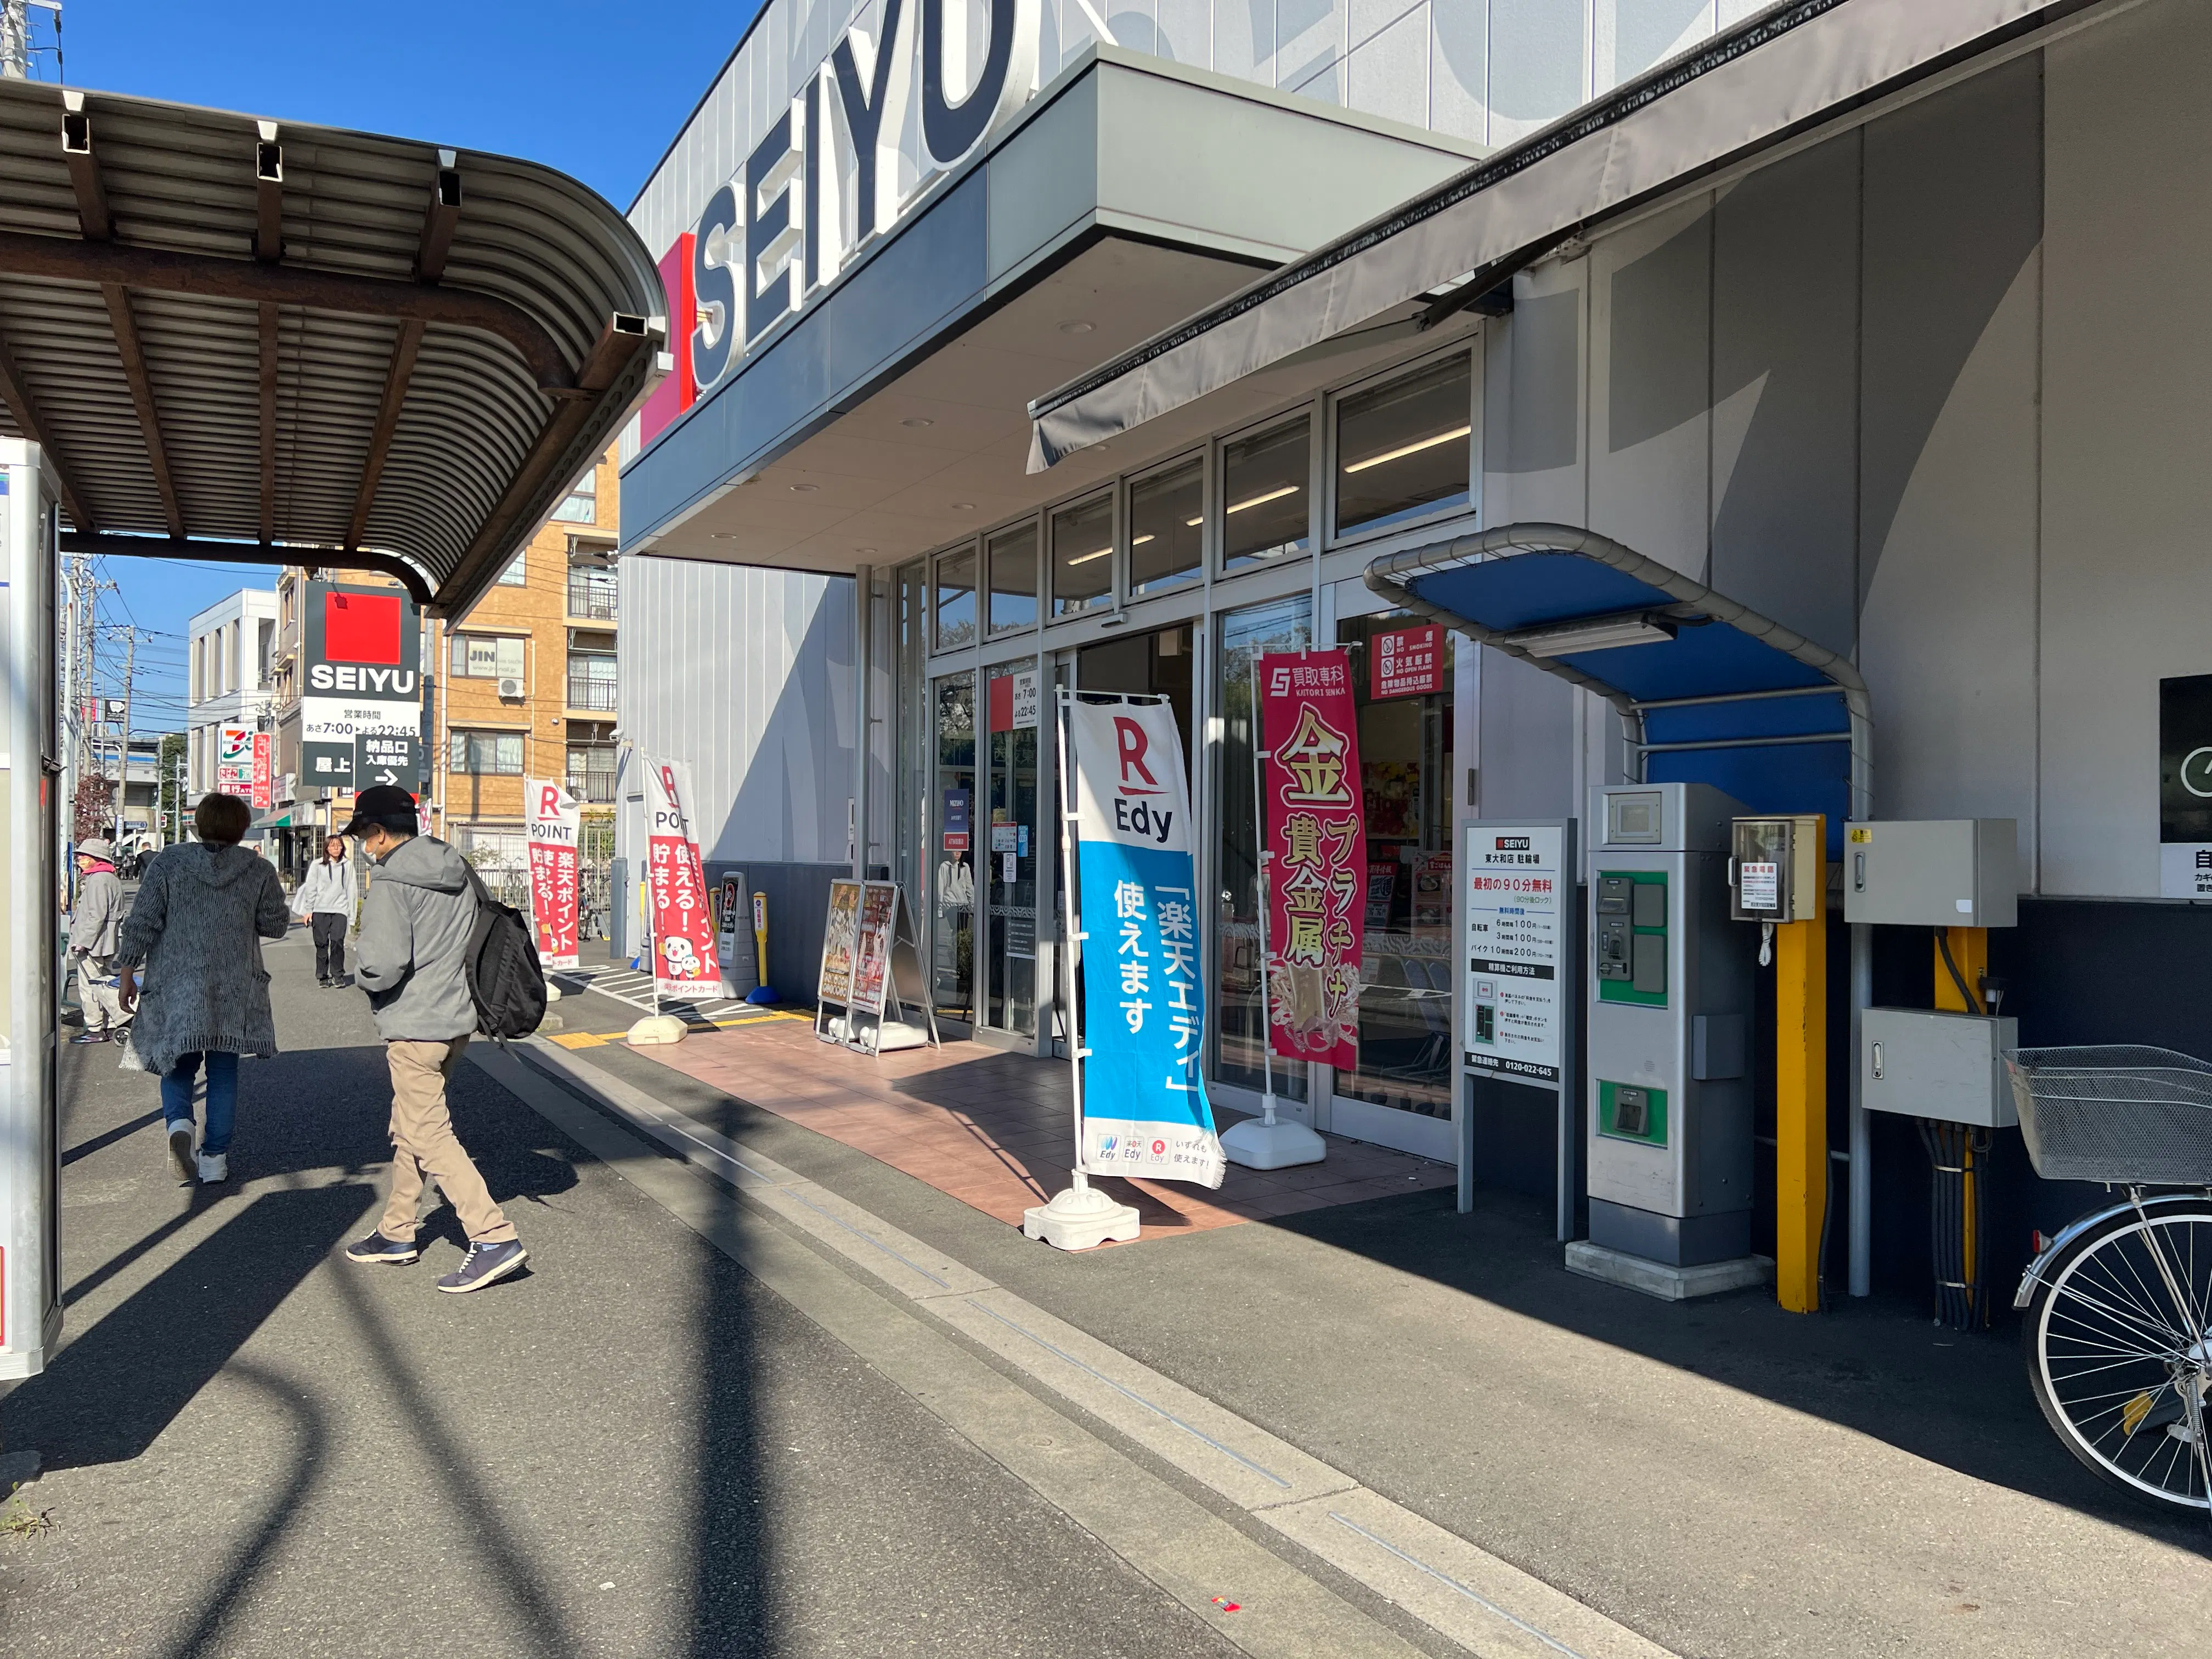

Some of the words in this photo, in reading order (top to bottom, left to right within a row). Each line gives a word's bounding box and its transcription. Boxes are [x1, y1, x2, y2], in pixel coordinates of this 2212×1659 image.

[692, 0, 1024, 392] SEIYU
[1409, 642, 1432, 651] SMOKING
[470, 650, 495, 662] JIN
[311, 664, 414, 694] SEIYU
[1292, 663, 1344, 687] 買取専科
[1023, 687, 1036, 699] 7:00
[1295, 689, 1324, 697] KAITORI
[1325, 687, 1346, 696] SENKA
[1389, 686, 1415, 695] DANGEROUS
[344, 709, 381, 720] 営業時間
[366, 740, 408, 754] 納品口
[1113, 715, 1159, 786] R
[366, 755, 408, 766] 入庫優先
[1279, 707, 1352, 805] 金
[315, 757, 351, 773] 屋上
[540, 786, 560, 816] R
[1114, 797, 1173, 843] Edy
[531, 823, 572, 840] POINT
[1504, 839, 1528, 849] SEIYU
[1485, 853, 1514, 864] 東大和店
[1517, 854, 1540, 864] 駐輪場
[2196, 850, 2212, 868] 自
[1474, 877, 1552, 893] 最初の90分無料
[2194, 873, 2212, 882] カギ
[652, 843, 670, 932] 貯まる!
[675, 843, 695, 933] 使える!
[1284, 815, 1328, 966] 貴金属
[557, 851, 574, 951] 楽天ポイント
[1327, 816, 1358, 1019] プラチナ
[1471, 923, 1488, 932] 自転車
[1114, 879, 1152, 1035] 使えます
[1471, 945, 1488, 953] バイク
[1488, 962, 1536, 975] 精算機ご利用方法
[1155, 884, 1200, 1092] 「楽天エディ」
[1505, 1060, 1552, 1076] 0120-022-645
[1125, 1149, 1141, 1160] Edy
[1176, 1140, 1207, 1153] いずれも
[1100, 1150, 1116, 1160] Edy
[1151, 1153, 1165, 1163] Edy
[1174, 1153, 1210, 1169] 使えます!
